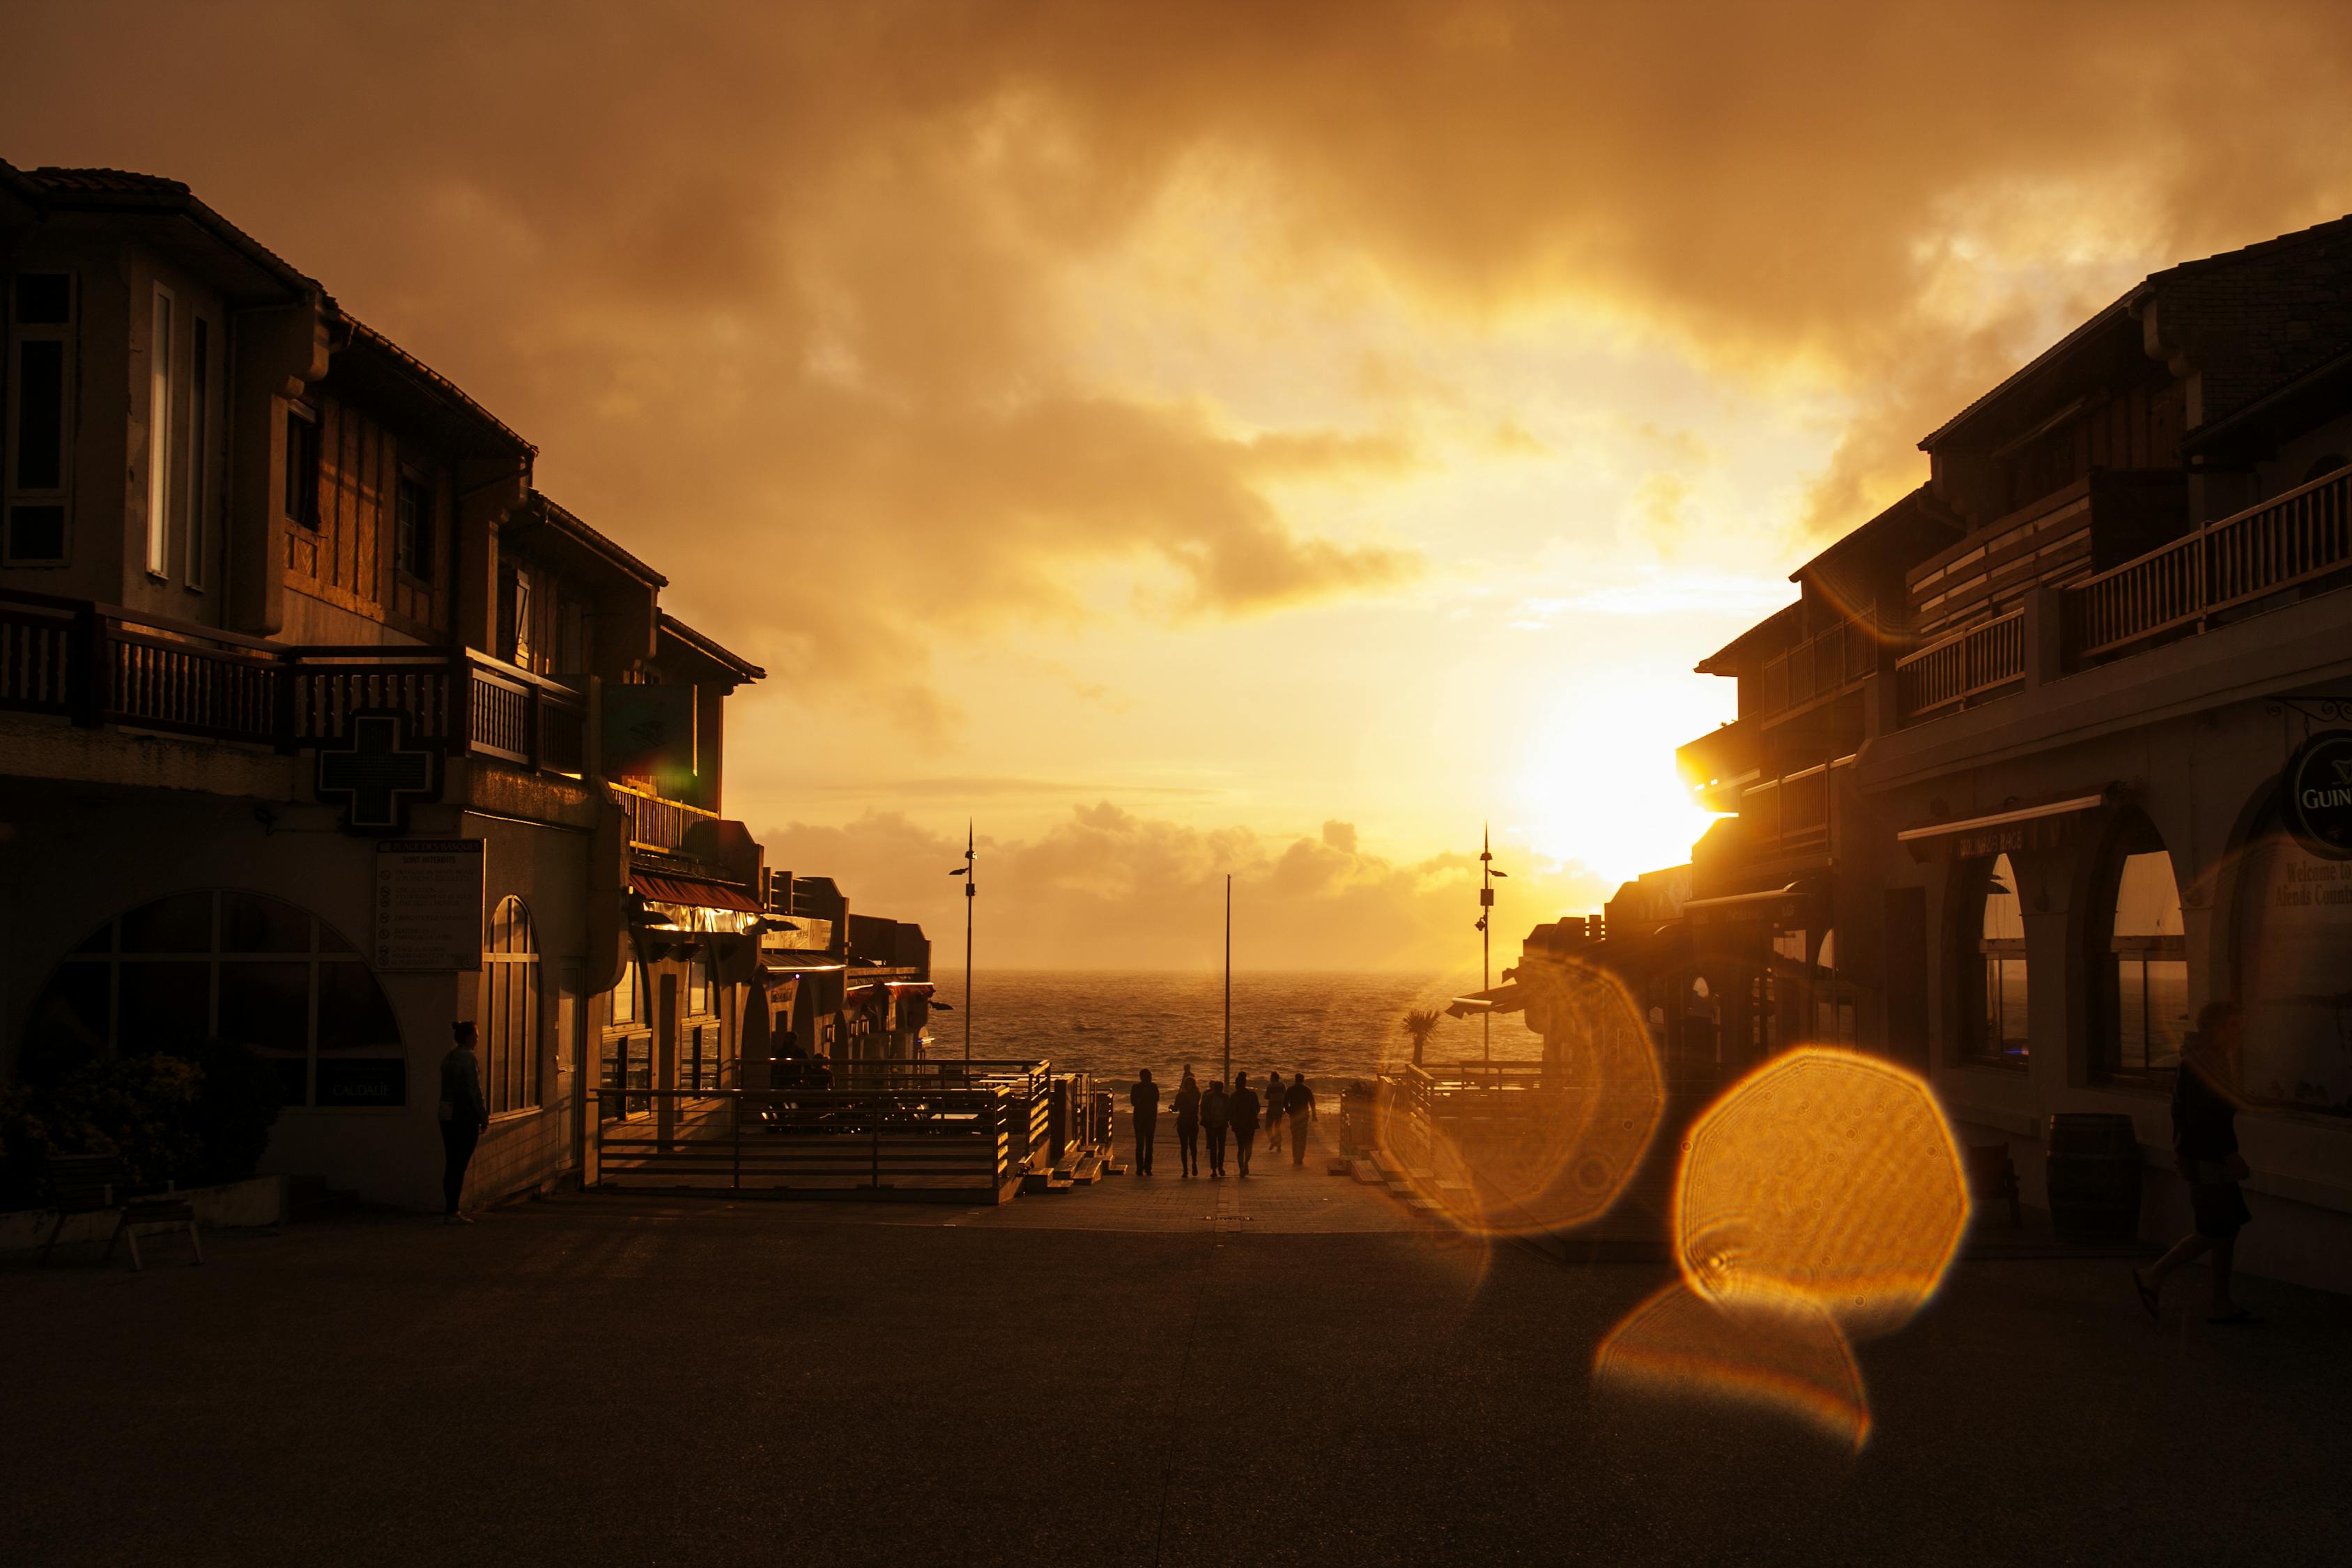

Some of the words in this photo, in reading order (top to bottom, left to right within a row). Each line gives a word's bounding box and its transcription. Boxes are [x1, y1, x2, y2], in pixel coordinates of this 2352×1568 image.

[2302, 787, 2352, 809] GUIN
[402, 856, 420, 864] SONT
[422, 856, 456, 864] INTERDITS
[2286, 860, 2336, 882] Welcome
[2340, 861, 2351, 881] to
